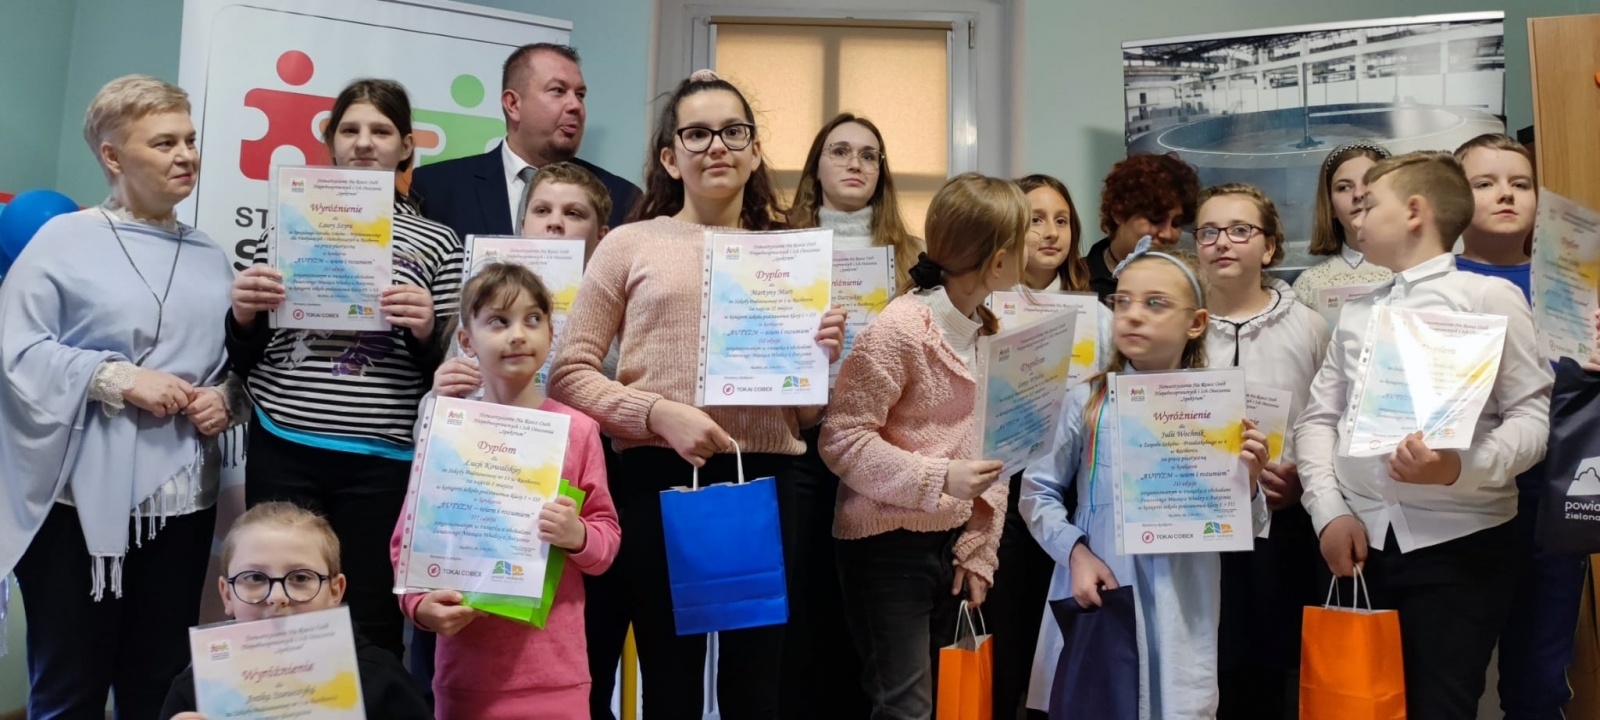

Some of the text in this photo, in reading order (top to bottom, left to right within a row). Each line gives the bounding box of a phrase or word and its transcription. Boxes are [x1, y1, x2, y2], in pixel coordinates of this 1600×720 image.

[310, 203, 363, 215] Wyróżnienie
[756, 269, 790, 281] Dyplom
[1153, 410, 1212, 424] Wyróżnienie
[1176, 429, 1206, 438] Wochnik
[478, 440, 517, 455] Dyplom
[462, 570, 482, 578] COBEX
